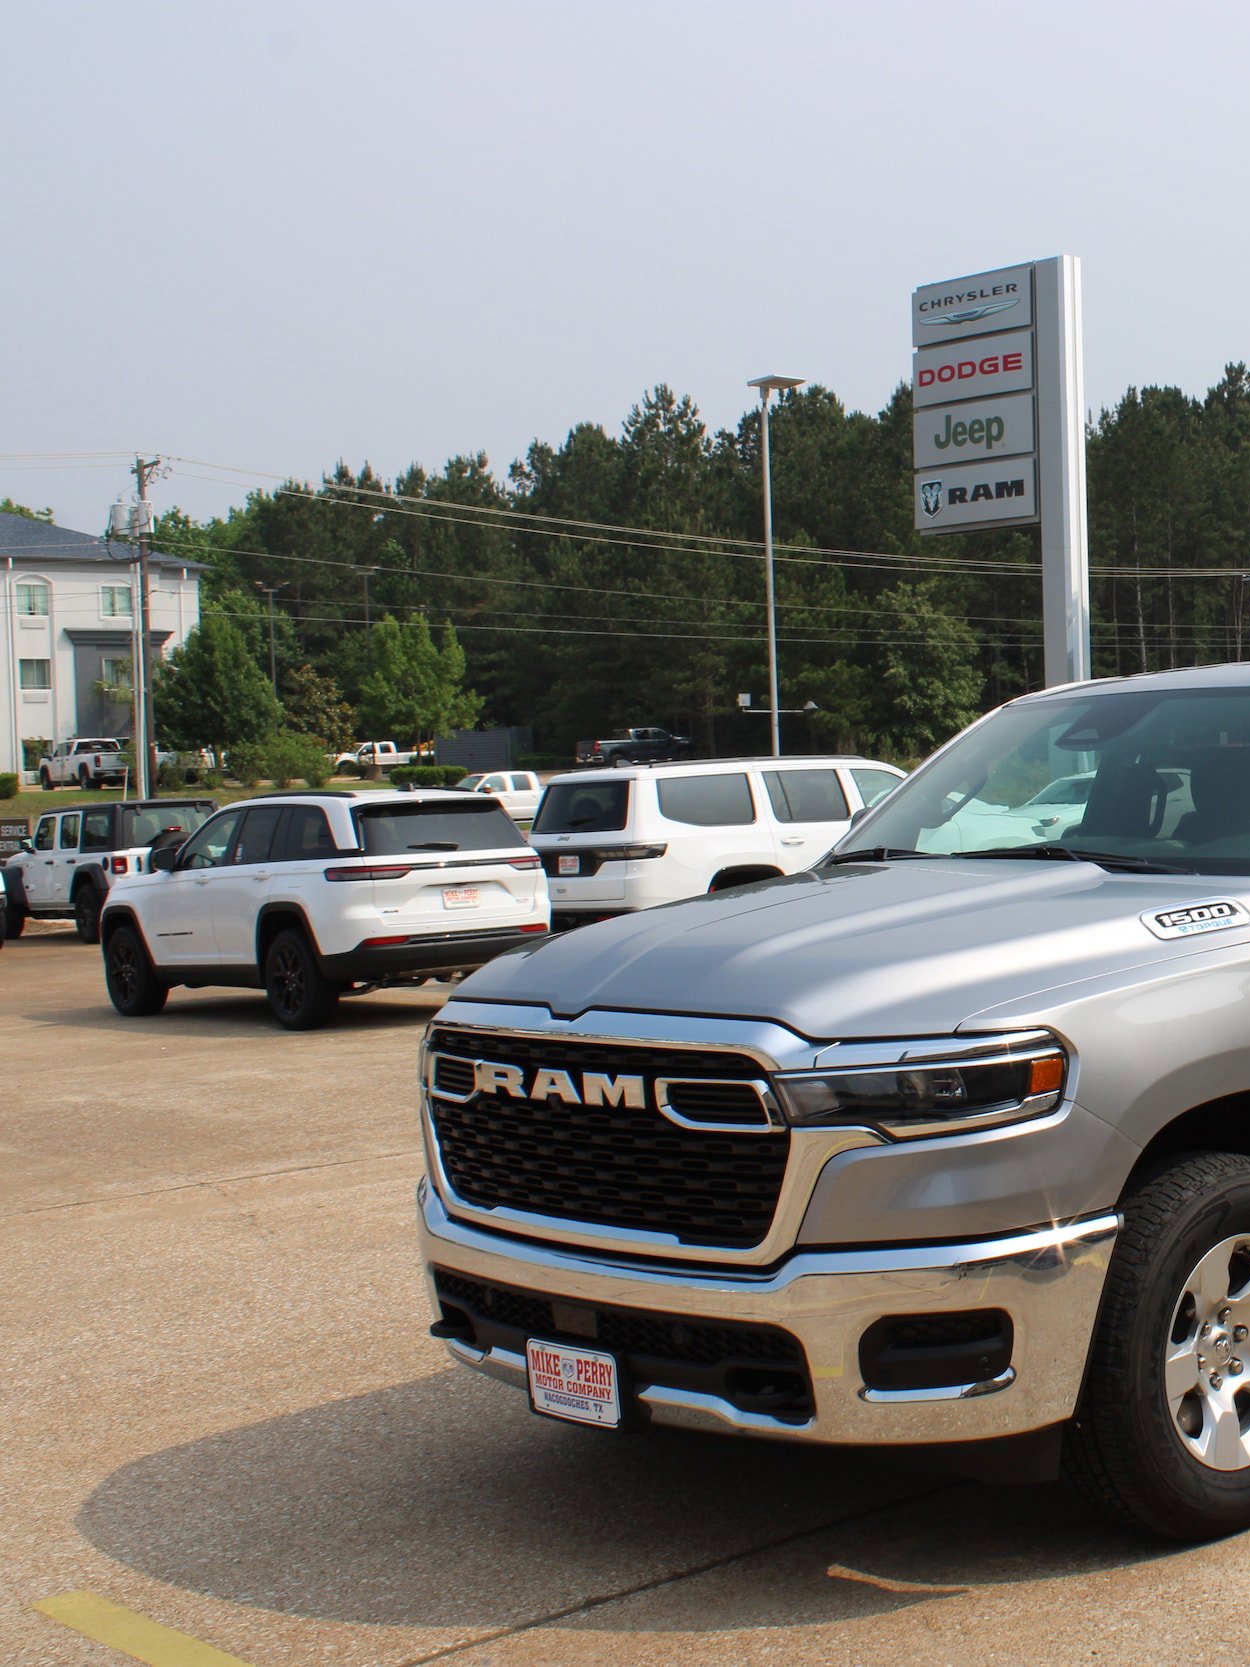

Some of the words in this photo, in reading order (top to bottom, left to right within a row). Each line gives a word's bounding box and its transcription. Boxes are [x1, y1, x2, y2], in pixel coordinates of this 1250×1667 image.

[919, 283, 1018, 312] CHRYSLER
[918, 353, 1022, 387] DODGE
[934, 415, 1005, 450] Jeep
[948, 479, 1025, 505] RAM
[1, 825, 26, 836] SERVICE
[1158, 905, 1231, 927] 1500
[479, 1061, 645, 1109] RAM
[531, 1349, 561, 1377] MIKE
[576, 1358, 612, 1387] PERRY
[535, 1373, 564, 1391] MOTOR
[567, 1381, 612, 1400] COMPANY
[594, 1402, 604, 1413] TX
